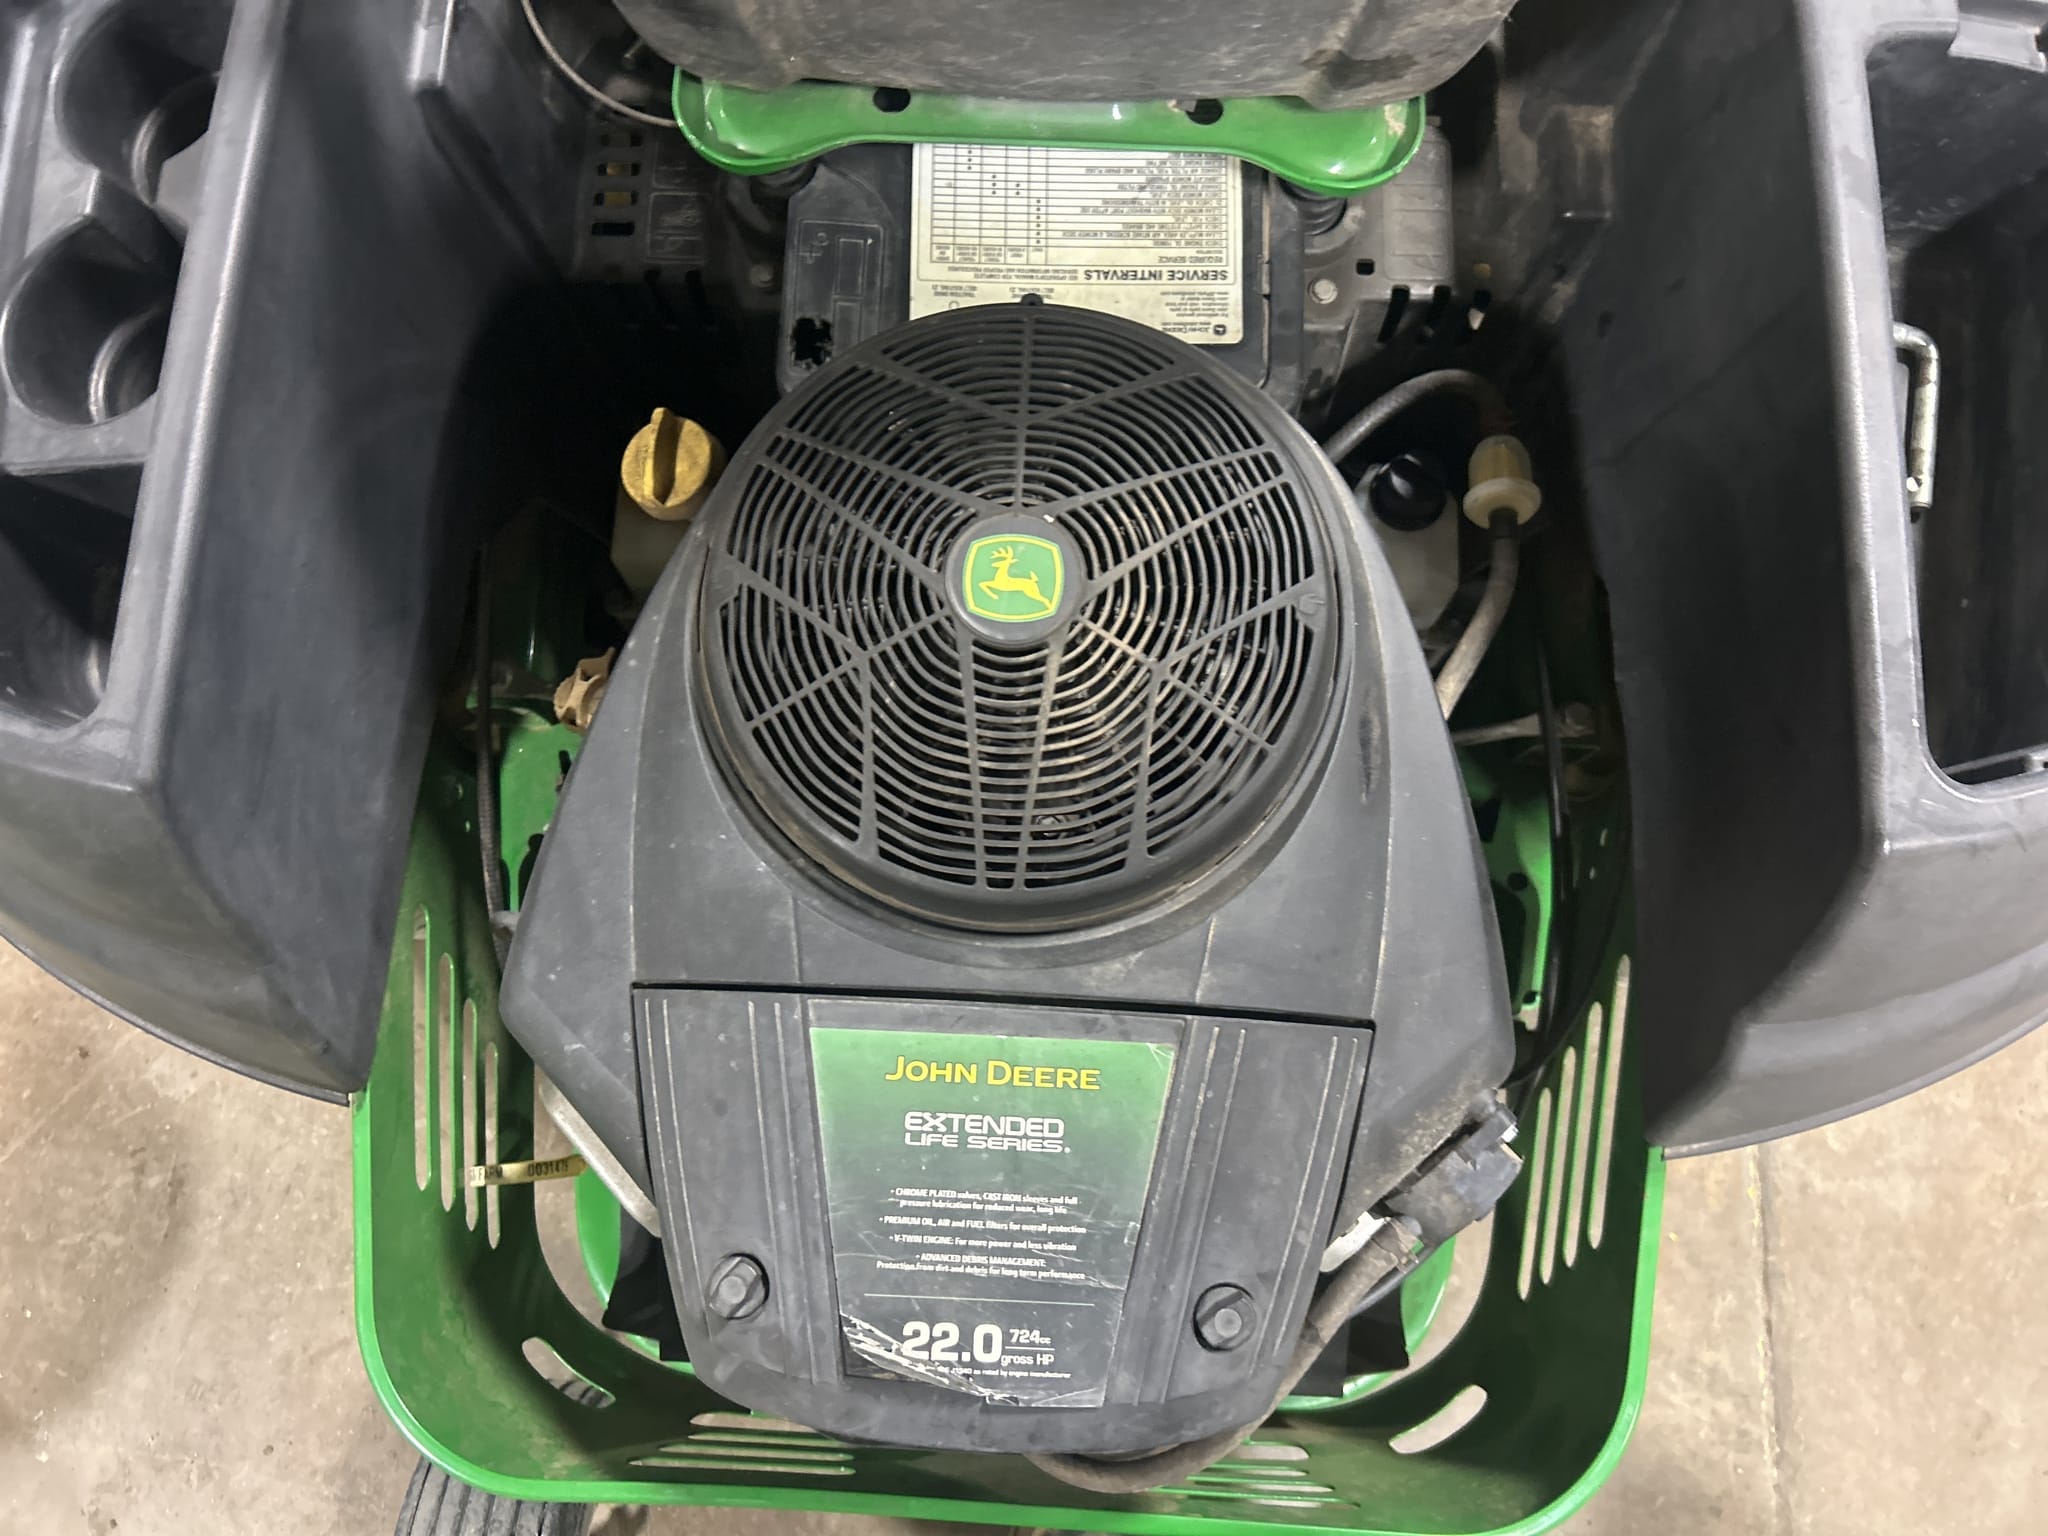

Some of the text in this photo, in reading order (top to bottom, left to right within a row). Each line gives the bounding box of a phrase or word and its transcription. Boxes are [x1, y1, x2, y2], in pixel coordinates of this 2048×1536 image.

[1083, 269, 1228, 281] SERVICE INTERVALS
[885, 1055, 1101, 1091] JOHN DEERE
[904, 1111, 1065, 1138] EXTENDED
[904, 1132, 959, 1148] LIFE
[896, 1188, 928, 1196] CHROME
[929, 1189, 956, 1198] PLATED
[1023, 1194, 1048, 1203] sleeves
[1065, 1196, 1078, 1204] full
[932, 1199, 971, 1209] lubrication
[972, 1202, 984, 1210] for
[984, 1203, 1014, 1211] reduced
[1037, 1205, 1054, 1215] long
[1054, 1206, 1068, 1214] life
[884, 1216, 921, 1224] PREMIUM
[938, 1218, 950, 1226] AIR
[966, 1220, 985, 1228] FUEL
[1009, 1222, 1020, 1230] for
[1021, 1223, 1047, 1231] overall
[1048, 1225, 1087, 1233] protection
[894, 1234, 922, 1243] V-TWIN
[1028, 1241, 1043, 1249] less
[1043, 1242, 1077, 1250] vibration
[921, 1253, 961, 1262] ADVANCED
[962, 1255, 988, 1264] DEBRIS
[917, 1262, 934, 1271] from
[935, 1264, 948, 1272] dirt
[950, 1265, 964, 1273] and
[965, 1265, 988, 1273] debris
[1001, 1267, 1018, 1278] long
[1038, 1269, 1085, 1279] performance
[902, 1320, 1052, 1364] 22.0 724cc
[1001, 1354, 1055, 1367] gross HP
